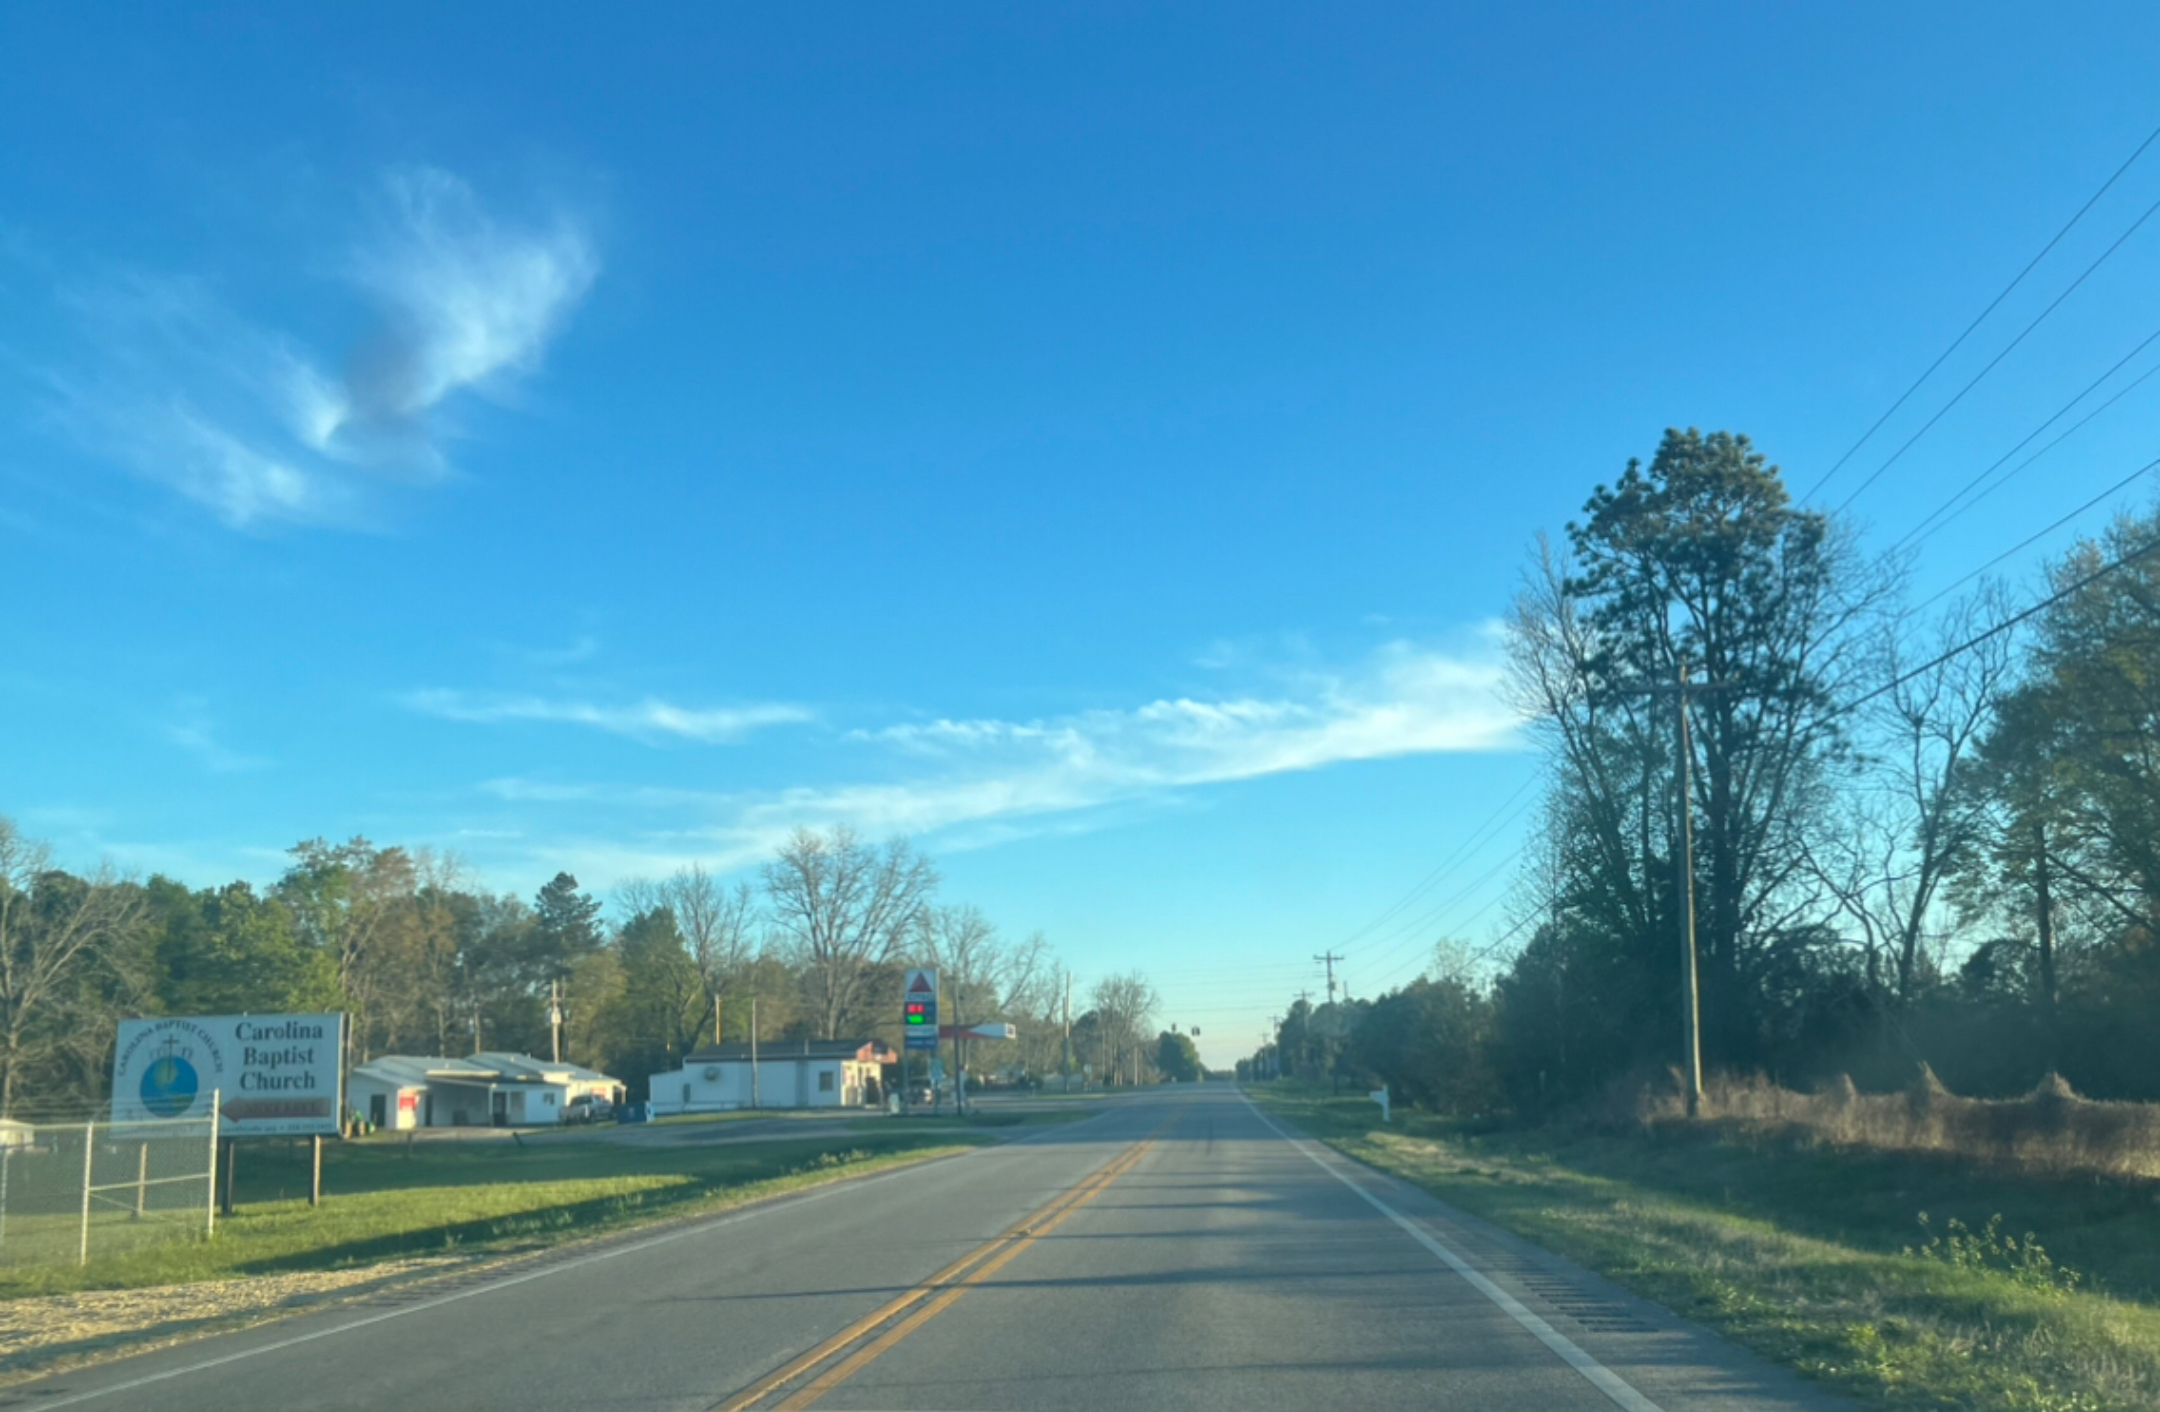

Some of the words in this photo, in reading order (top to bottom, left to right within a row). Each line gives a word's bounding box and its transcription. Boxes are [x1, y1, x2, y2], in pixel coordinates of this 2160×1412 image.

[235, 1021, 323, 1040] Carolina
[155, 1020, 198, 1033] BAPTIST
[197, 1029, 223, 1073] CHURCH
[243, 1045, 314, 1070] Baptist
[239, 1070, 316, 1091] Church
